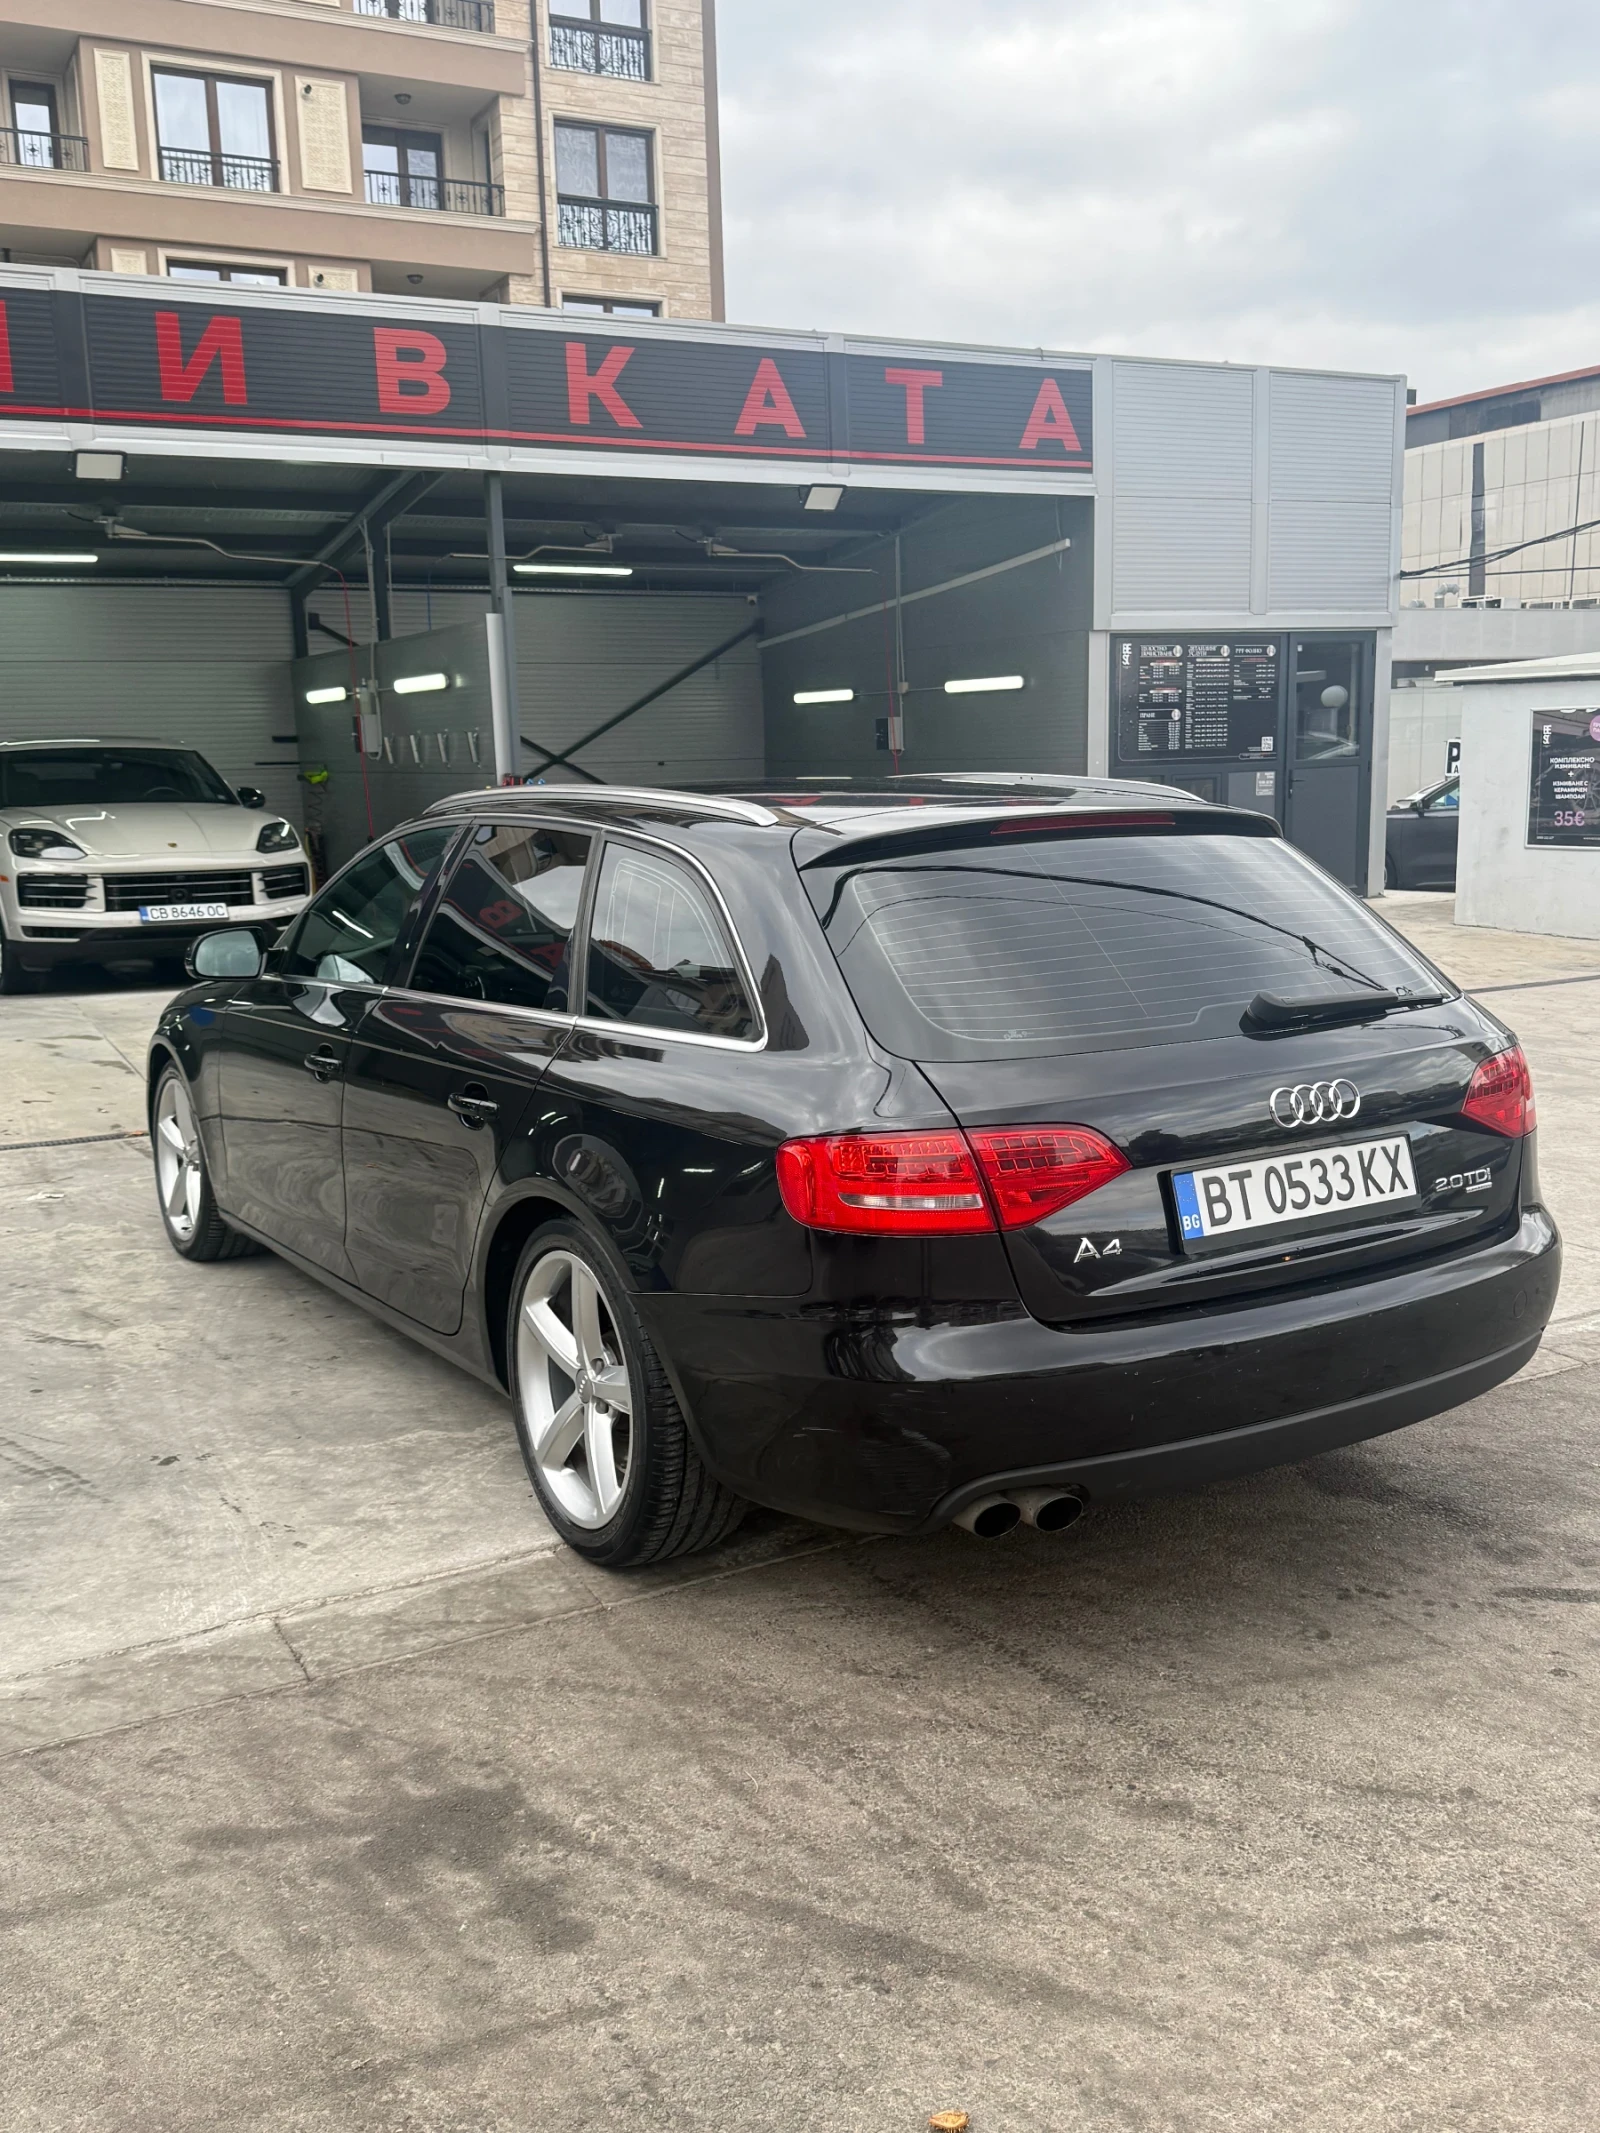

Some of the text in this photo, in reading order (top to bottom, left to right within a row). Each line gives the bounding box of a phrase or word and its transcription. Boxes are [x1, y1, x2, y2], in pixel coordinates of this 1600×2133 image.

[1549, 756, 1595, 764] КОМПЛЕКСНО
[1554, 810, 1585, 826] 35€
[150, 907, 169, 920] CB
[171, 906, 204, 918] 8646
[1203, 1144, 1408, 1228] BT 0533 KX
[1183, 1213, 1200, 1231] BG
[1073, 1236, 1123, 1264] A4
